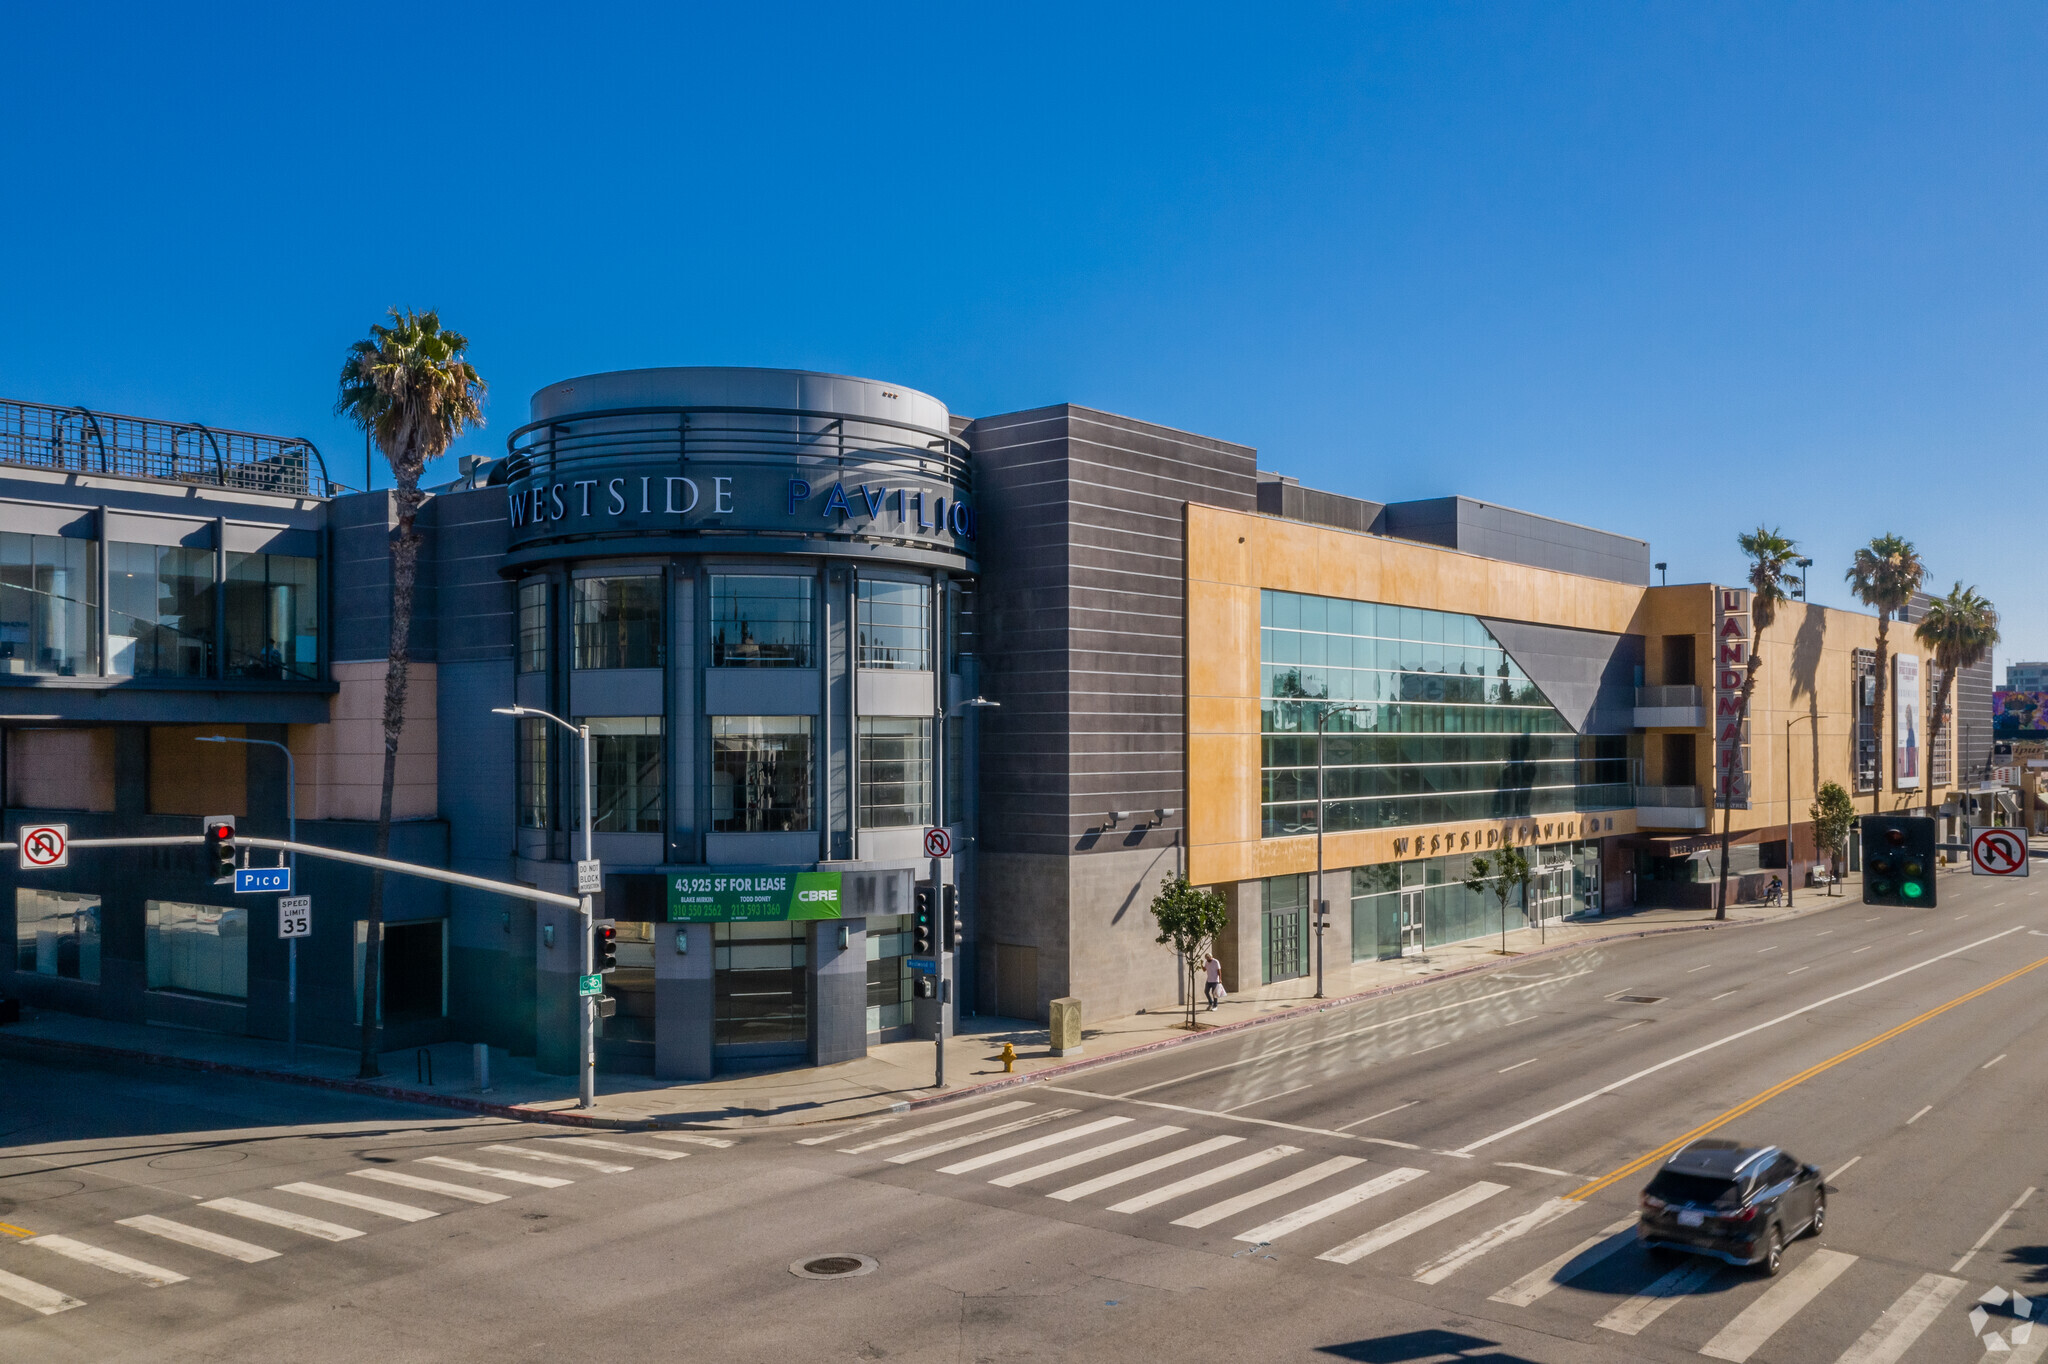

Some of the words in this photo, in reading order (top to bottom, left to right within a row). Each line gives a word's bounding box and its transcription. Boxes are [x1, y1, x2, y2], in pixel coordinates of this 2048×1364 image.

[508, 476, 734, 530] WESTSIDE
[1717, 592, 1744, 795] LANDMARK
[1394, 827, 1513, 855] WESTSIDE
[1519, 817, 1613, 841] PAVILION
[580, 865, 587, 873] DO
[589, 864, 598, 872] NOT
[580, 874, 599, 883] BLOCK
[675, 878, 711, 894] 43,925
[714, 878, 727, 892] SF
[730, 878, 751, 892] FOR
[755, 877, 786, 891] LEASE
[798, 889, 838, 902] CBRE
[282, 899, 308, 908] SPEED
[673, 904, 686, 916] 310
[688, 904, 702, 916] 550
[703, 904, 722, 916] 2562
[731, 904, 745, 916] 213
[747, 904, 760, 916] 593
[762, 903, 781, 915] 1360
[284, 909, 305, 917] LIMIT
[283, 918, 307, 934] 35
